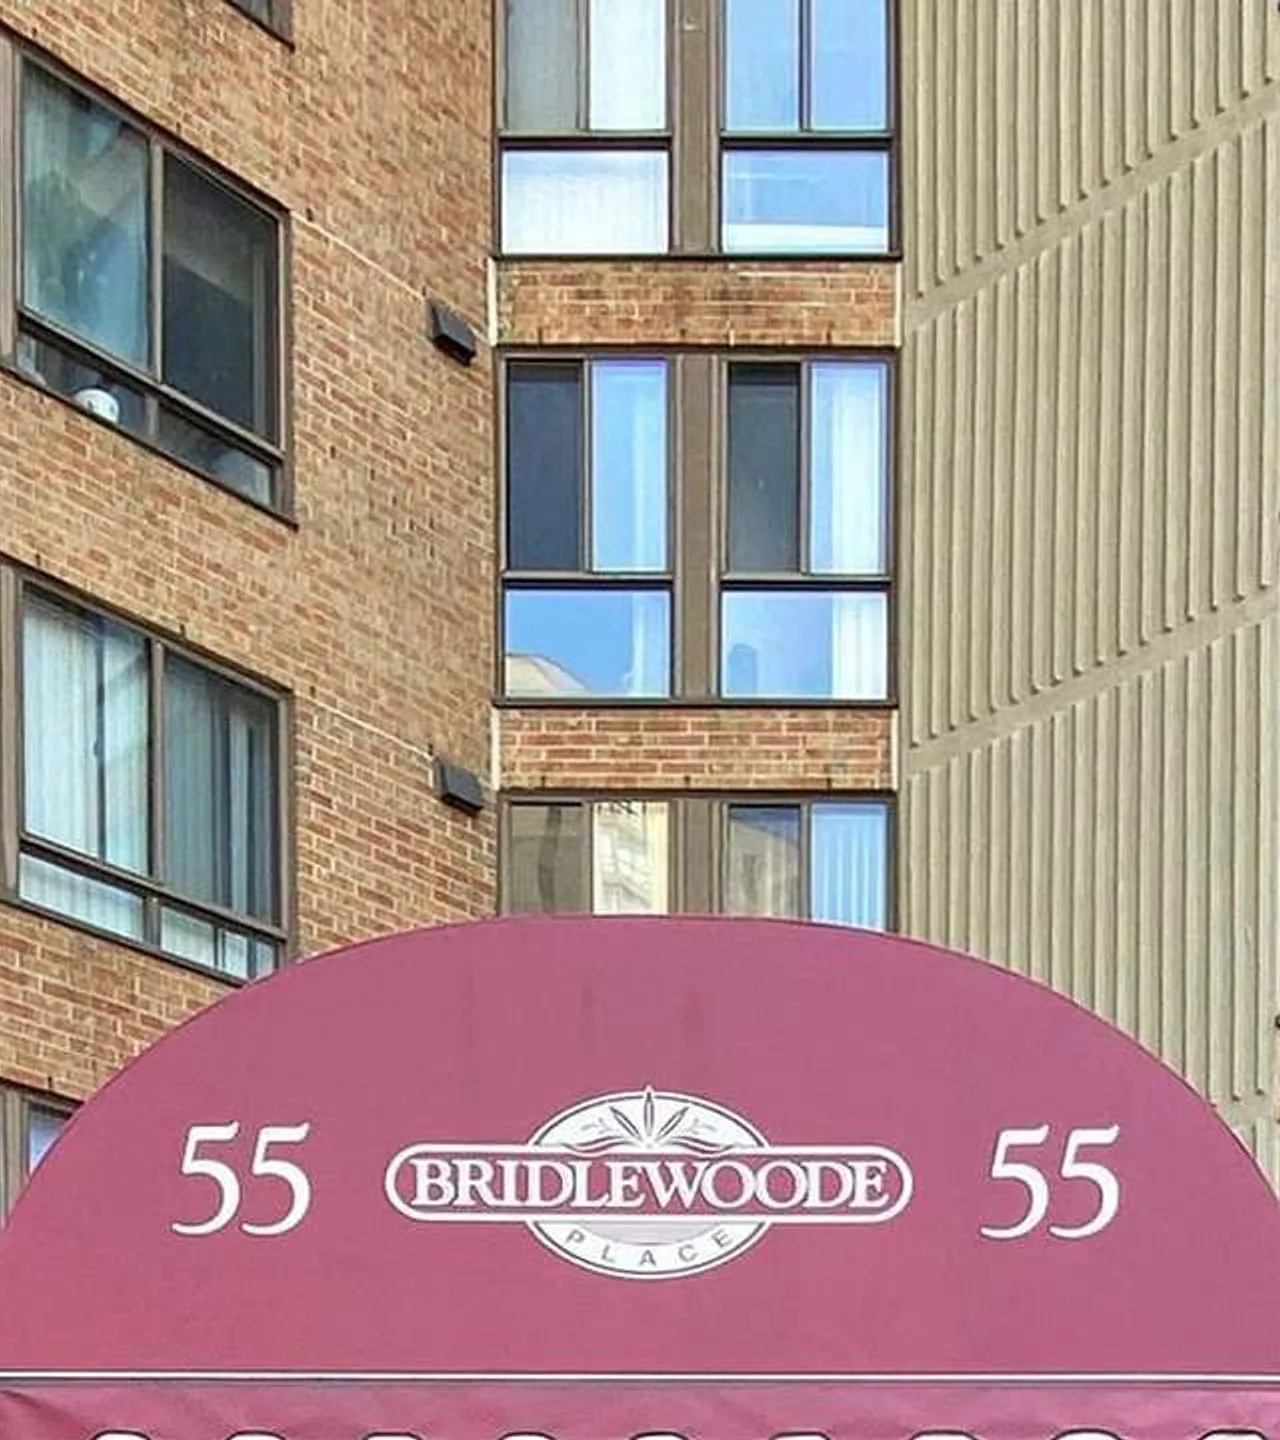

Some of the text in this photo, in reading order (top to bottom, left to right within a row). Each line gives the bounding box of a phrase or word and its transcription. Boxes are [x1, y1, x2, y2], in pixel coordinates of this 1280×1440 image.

[170, 1121, 312, 1236] 55
[408, 1157, 891, 1209] BRIDLEWOODE
[978, 1122, 1122, 1240] 55
[564, 1227, 734, 1268] PLACE
